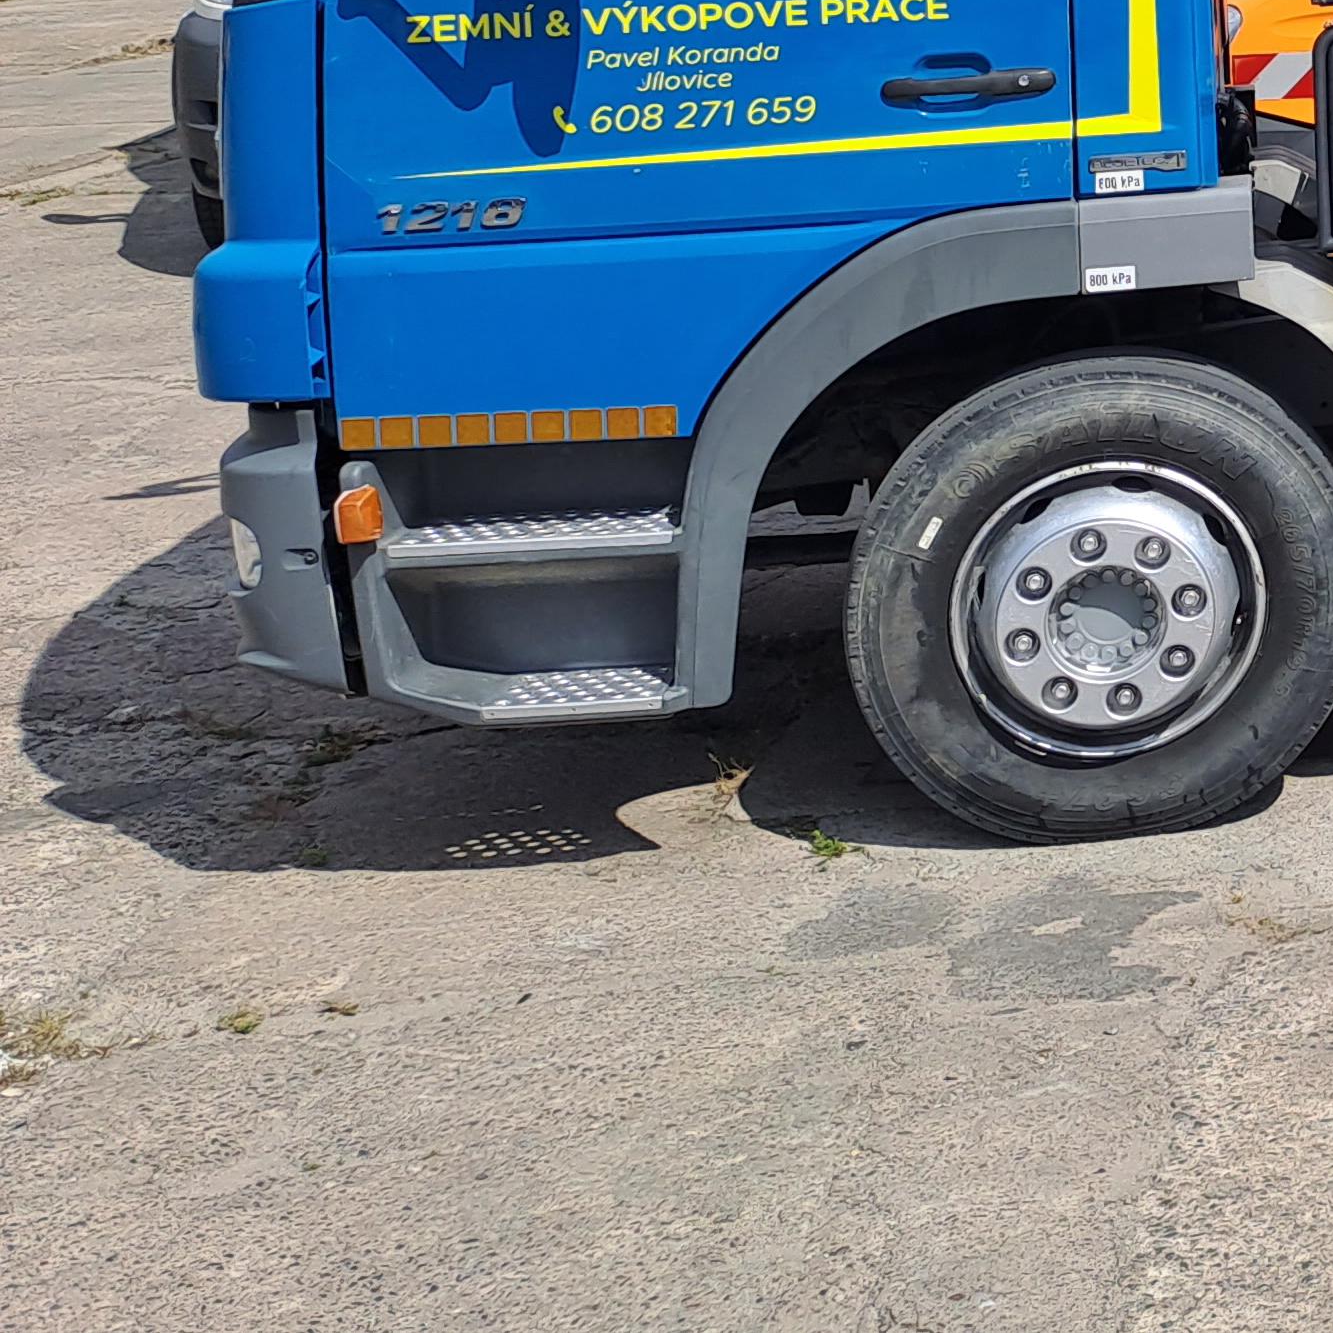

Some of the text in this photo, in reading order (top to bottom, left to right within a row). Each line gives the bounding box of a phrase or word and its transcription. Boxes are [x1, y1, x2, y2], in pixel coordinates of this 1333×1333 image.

[406, 3, 535, 44] ZEMNÍ
[544, 9, 572, 38] &
[586, 42, 781, 69] Pavel Koranda
[636, 69, 733, 92] Jílovice
[590, 95, 817, 134] 608 271 659
[1089, 272, 1132, 286] 800 kPa
